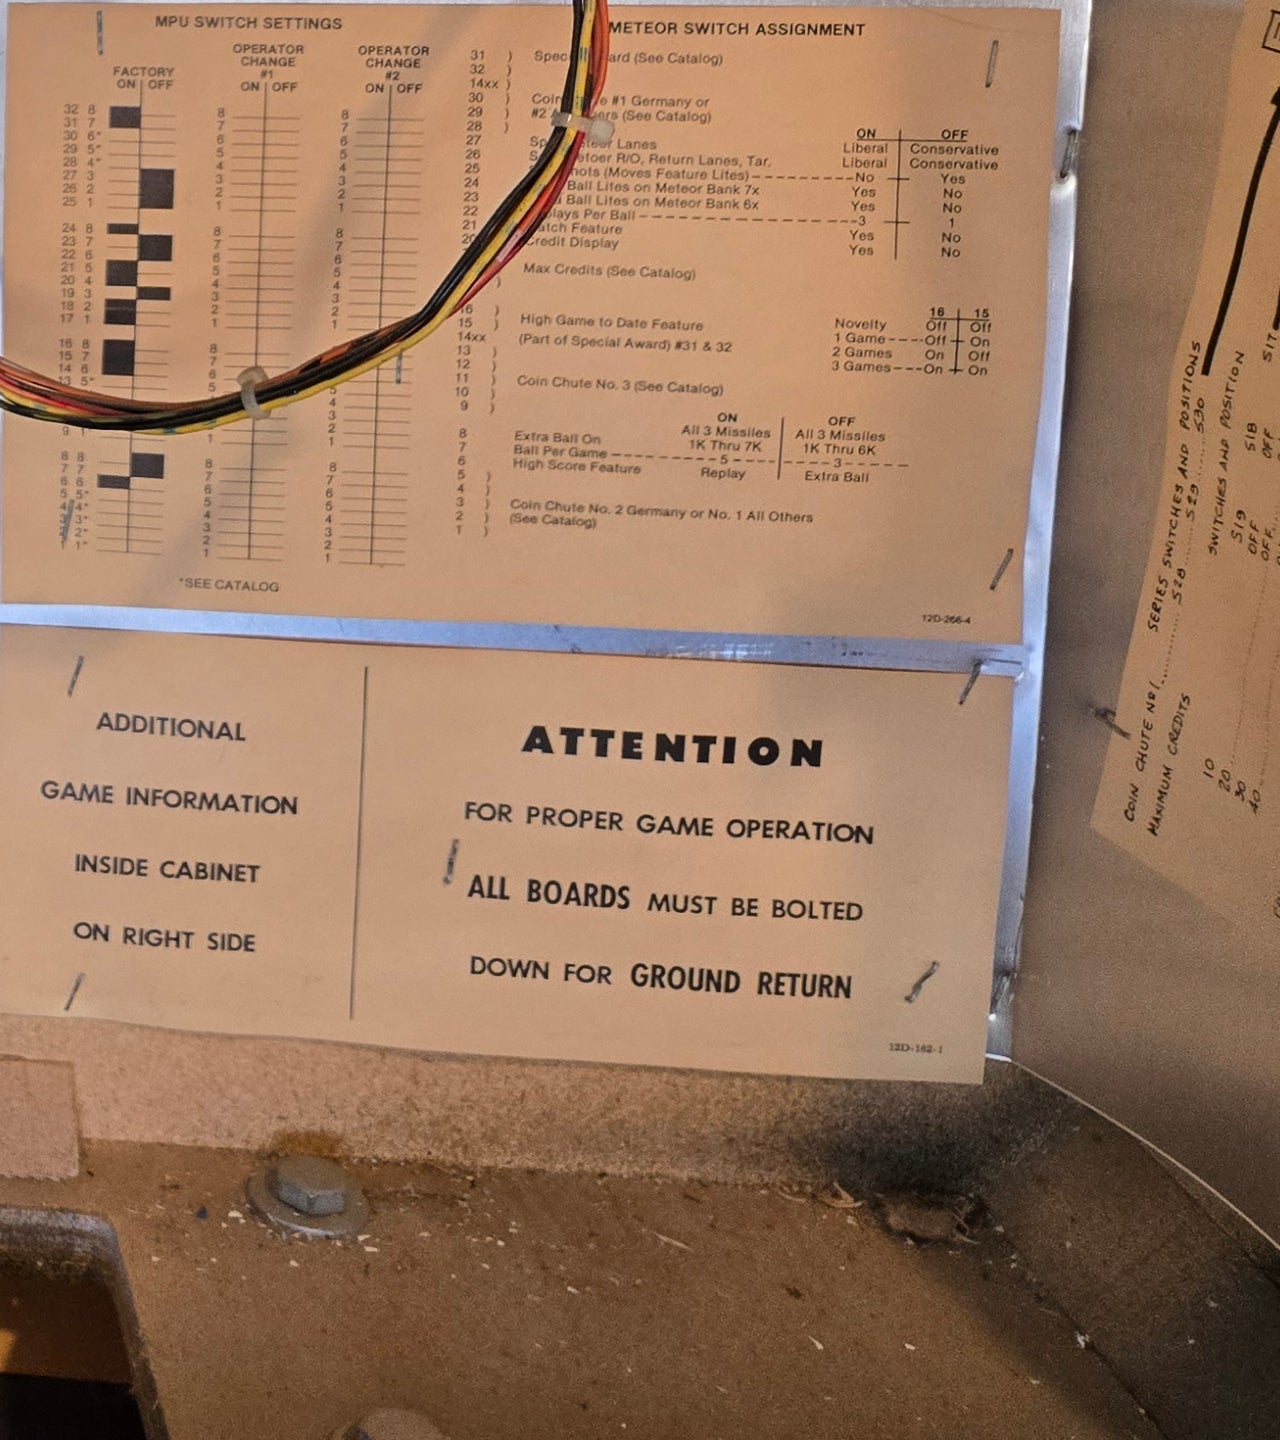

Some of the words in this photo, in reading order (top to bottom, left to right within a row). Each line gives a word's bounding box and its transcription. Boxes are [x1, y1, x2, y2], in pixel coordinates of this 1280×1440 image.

[155, 15, 189, 28] MPU
[194, 15, 258, 29] SWITCH
[263, 16, 343, 30] SETTINGS
[608, 21, 679, 35] METEOR
[683, 22, 749, 36] SWITCH
[755, 22, 866, 37] ASSIGNMENT
[232, 43, 305, 55] OPERATOR
[240, 55, 296, 68] CHANGE
[633, 51, 664, 66] (See
[667, 52, 724, 68] Catalog)
[112, 65, 175, 78] FACTORY
[271, 81, 299, 93] OFF
[611, 95, 626, 107] #1
[631, 94, 693, 110] Germany
[940, 129, 969, 141] OFF
[843, 142, 889, 154] Liberal
[909, 142, 1000, 156] Conservative
[567, 179, 593, 192] Ball
[596, 180, 630, 193] Lites
[655, 182, 703, 194] Meteor
[706, 183, 741, 196] Bank
[523, 262, 551, 274] Max
[554, 263, 603, 277] Credits
[606, 264, 636, 279] (See
[639, 265, 697, 282] Catalog)
[520, 313, 553, 328] High
[555, 314, 596, 327] Game
[616, 316, 648, 330] Date
[651, 318, 704, 332] Feature
[834, 317, 888, 333] Novelty
[516, 374, 549, 387] Coin
[551, 376, 593, 389] Chute
[595, 378, 619, 391] No.
[633, 380, 664, 394] (See
[666, 381, 724, 398] Catalog)
[827, 416, 856, 427] OFF
[709, 439, 741, 452] Thru
[700, 466, 747, 482] Replay
[214, 579, 280, 593] CATALOG
[96, 711, 247, 742] ADDITIONAL
[521, 725, 823, 768] ATTENTION
[40, 780, 114, 805] GAME
[126, 786, 298, 815] INFORMATION
[464, 801, 513, 823] FOR
[526, 805, 624, 832] PROPER
[636, 813, 714, 837] GAME
[726, 818, 874, 845] OPERATION
[75, 853, 149, 877] INSIDE
[159, 860, 261, 883] CABINET
[467, 874, 511, 901] ALL
[527, 878, 630, 910] BOARDS
[647, 892, 718, 915] MUST
[731, 897, 759, 918] BE
[771, 899, 864, 922] BOLTED
[73, 921, 110, 943] ON
[122, 926, 195, 949] RIGHT
[207, 932, 256, 953] SIDE
[470, 955, 550, 980] DOWN
[563, 963, 612, 985] FOR
[630, 962, 741, 994] GROUND
[756, 971, 852, 999] RETURN
